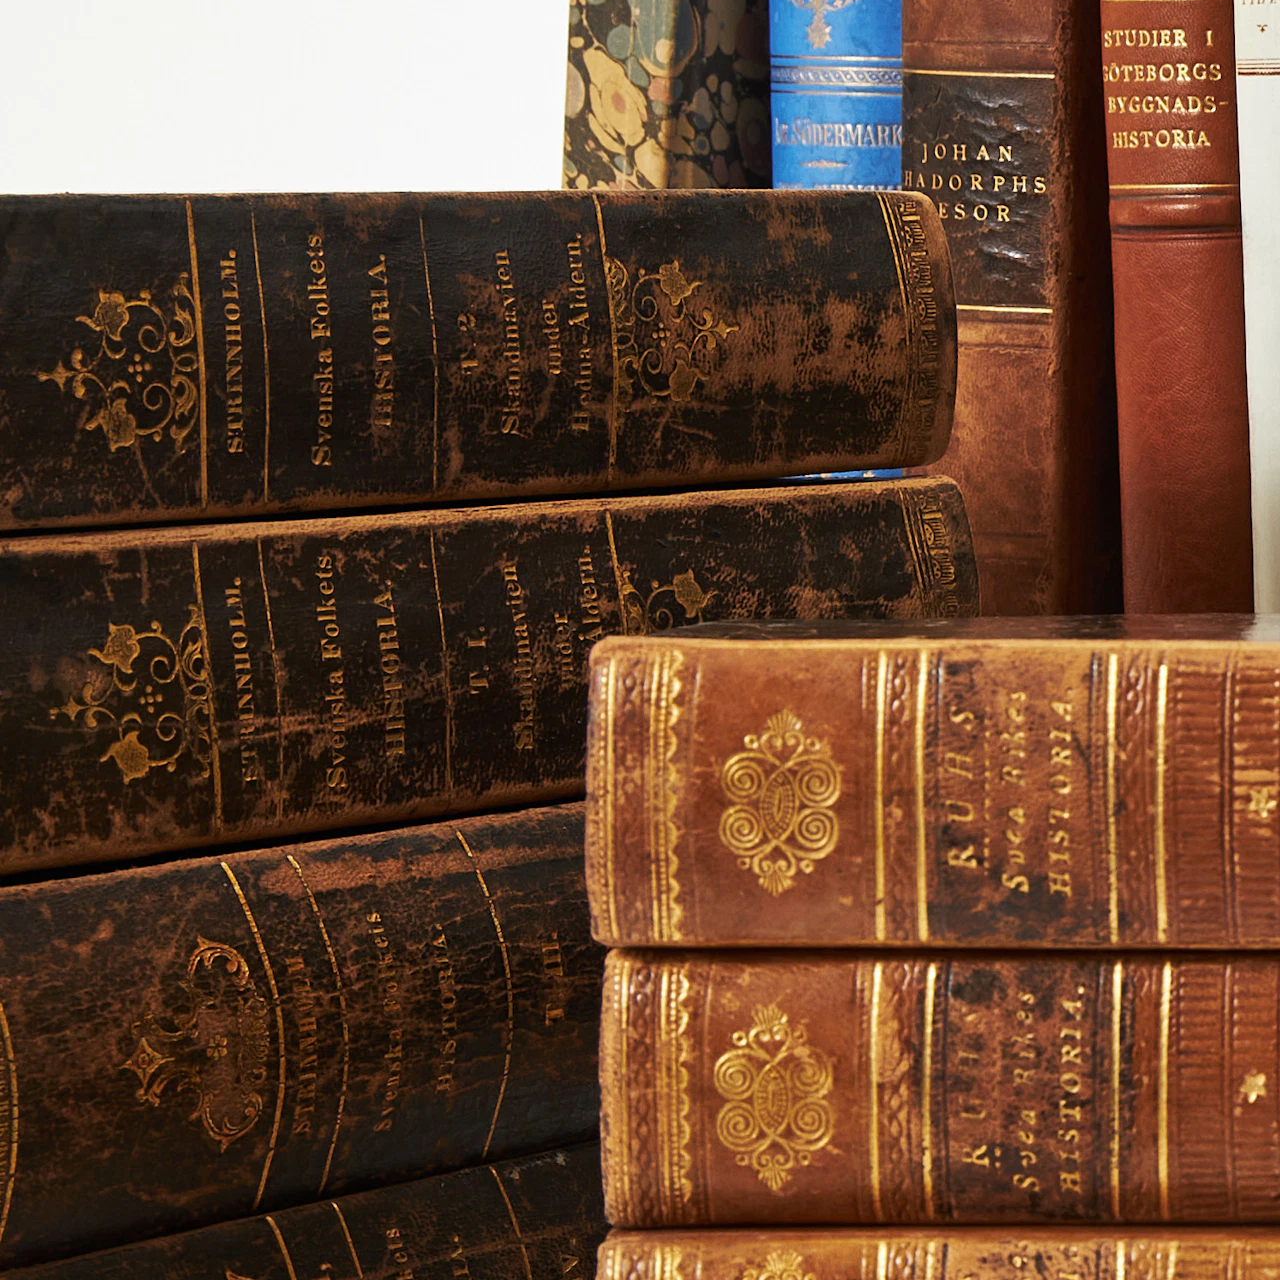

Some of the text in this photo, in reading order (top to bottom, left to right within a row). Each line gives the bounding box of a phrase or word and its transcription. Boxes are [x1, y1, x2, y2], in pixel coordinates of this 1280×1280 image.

[1104, 29, 1213, 48] STUDIER I
[1103, 62, 1221, 82] GÖTEBORGS
[1108, 95, 1228, 114] BYGGNADS-
[1112, 129, 1211, 149] HISTORIA
[921, 143, 1013, 164] JOHAN
[904, 170, 1046, 195] HADORPHS
[938, 202, 1010, 222] ESOR
[304, 234, 334, 466] Svenska Folkets
[312, 554, 348, 788] Svenska Folkets
